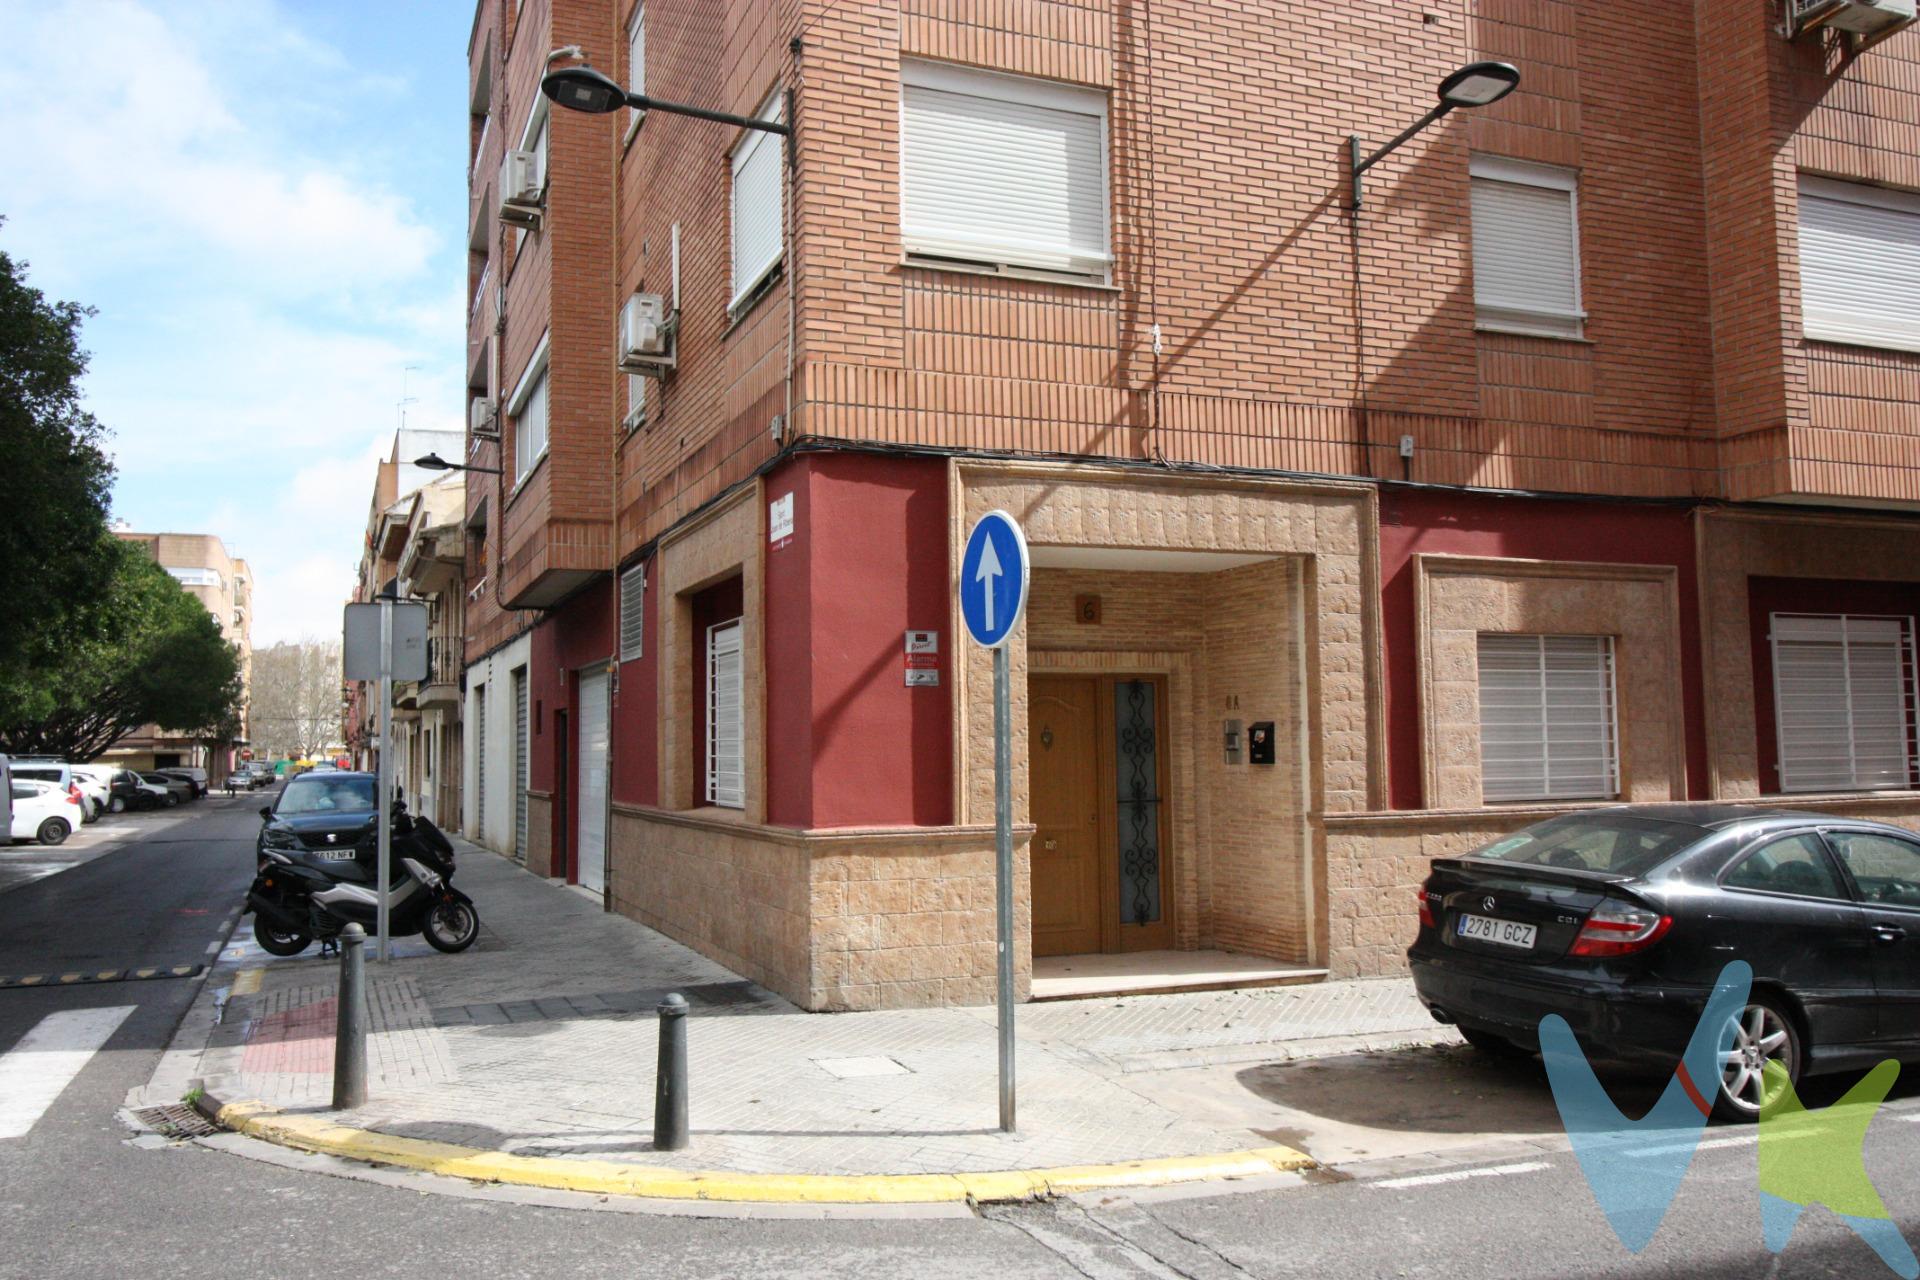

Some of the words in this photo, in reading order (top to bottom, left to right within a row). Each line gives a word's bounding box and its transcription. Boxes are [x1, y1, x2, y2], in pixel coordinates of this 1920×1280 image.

[1084, 602, 1094, 620] 6
[1467, 918, 1497, 937] 2781
[1504, 925, 1532, 944] GCZ
